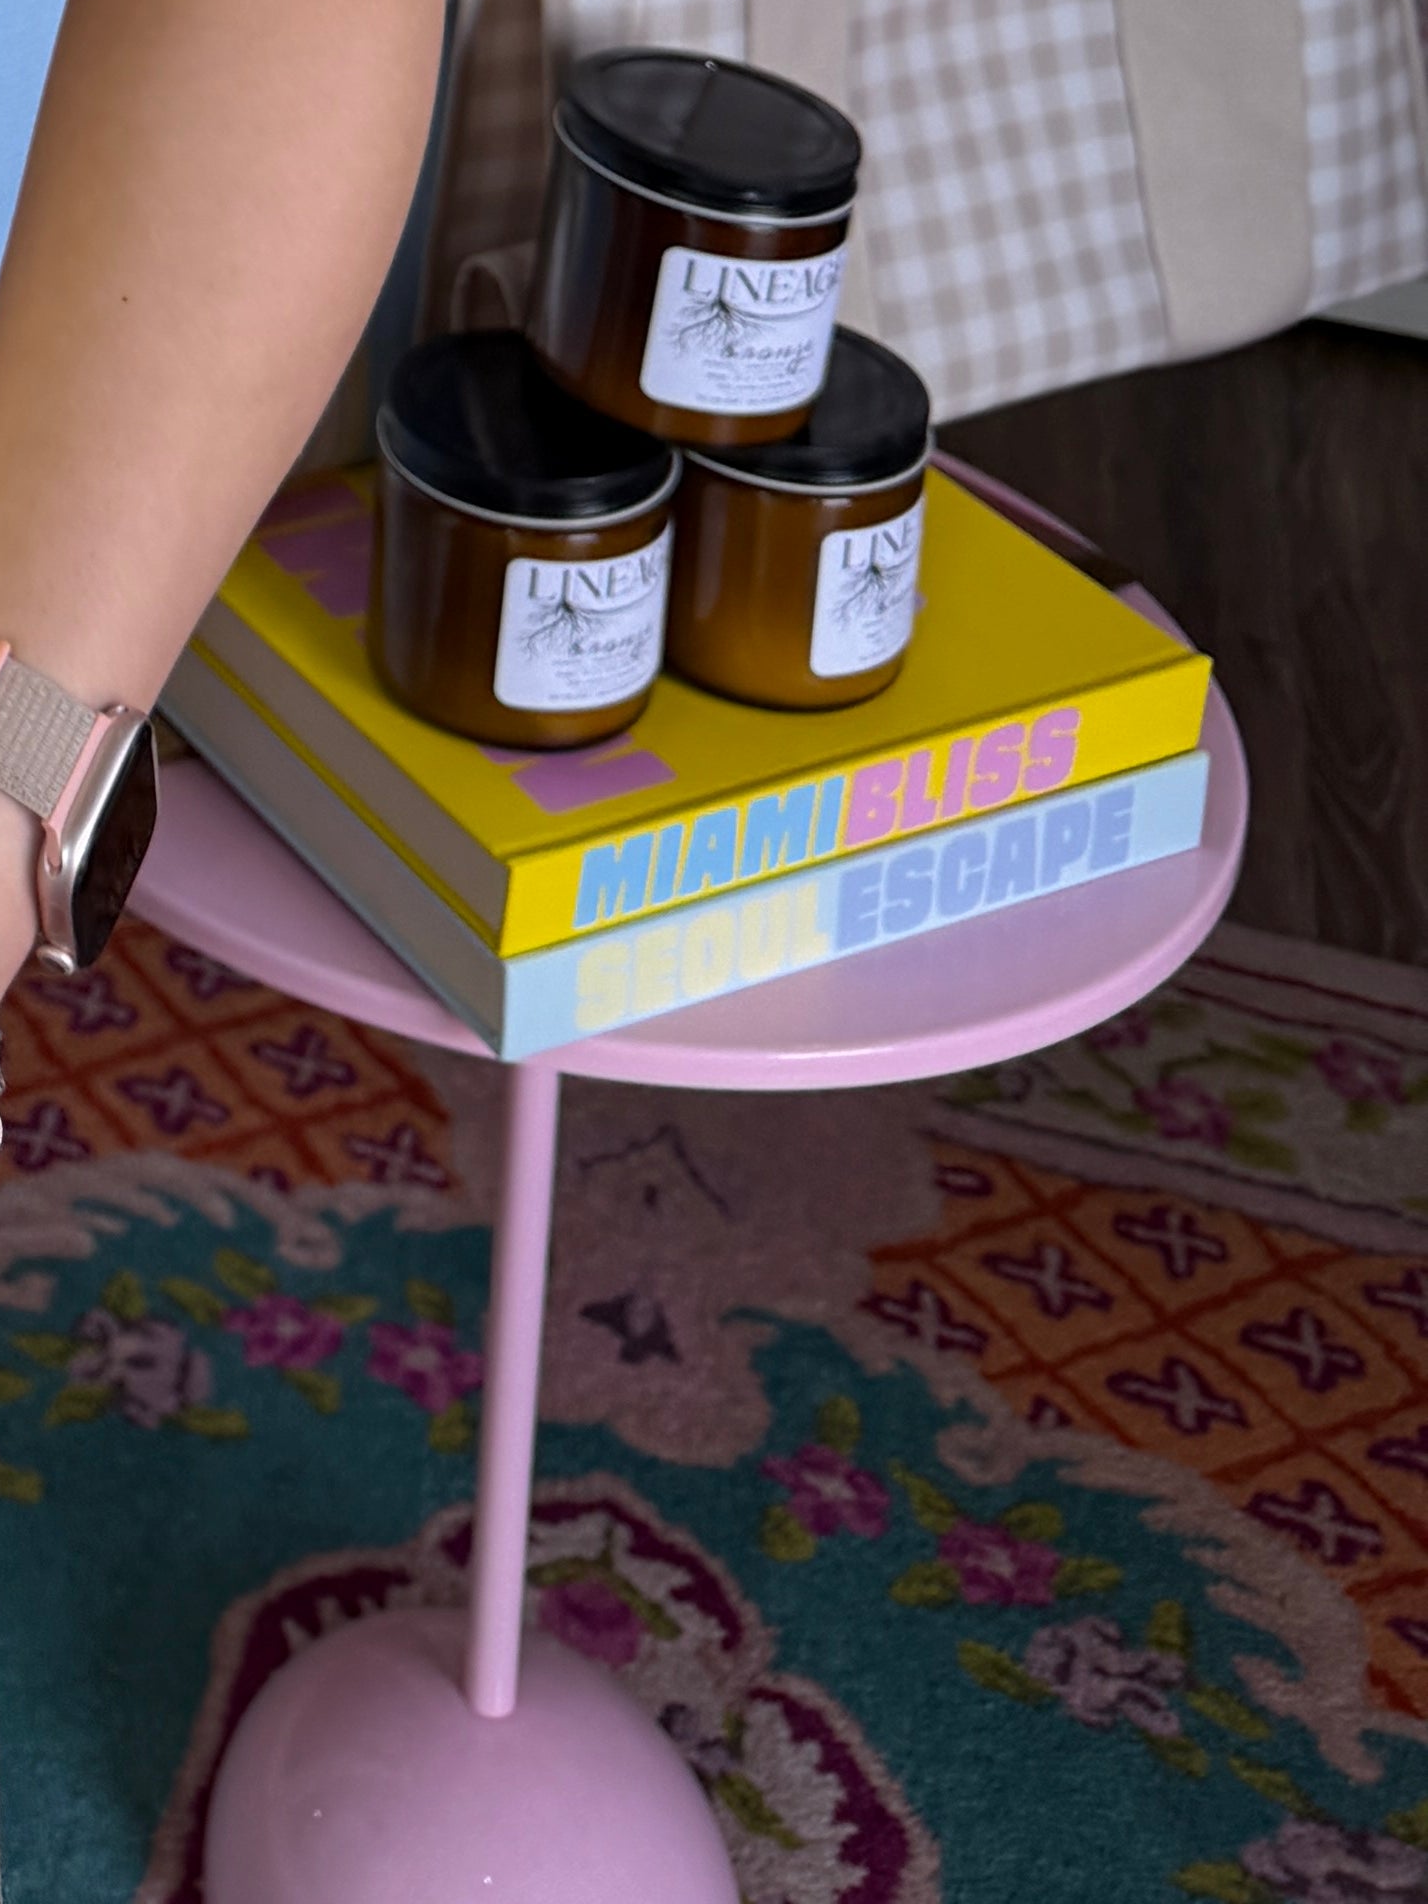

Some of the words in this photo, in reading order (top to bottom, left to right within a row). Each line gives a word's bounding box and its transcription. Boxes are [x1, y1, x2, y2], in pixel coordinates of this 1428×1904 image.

[682, 257, 843, 304] LINEAG
[573, 775, 846, 929] MIAMI
[844, 707, 1082, 847] BLISS
[575, 881, 830, 1031] SEOUL
[835, 786, 1135, 951] ESCAPE
